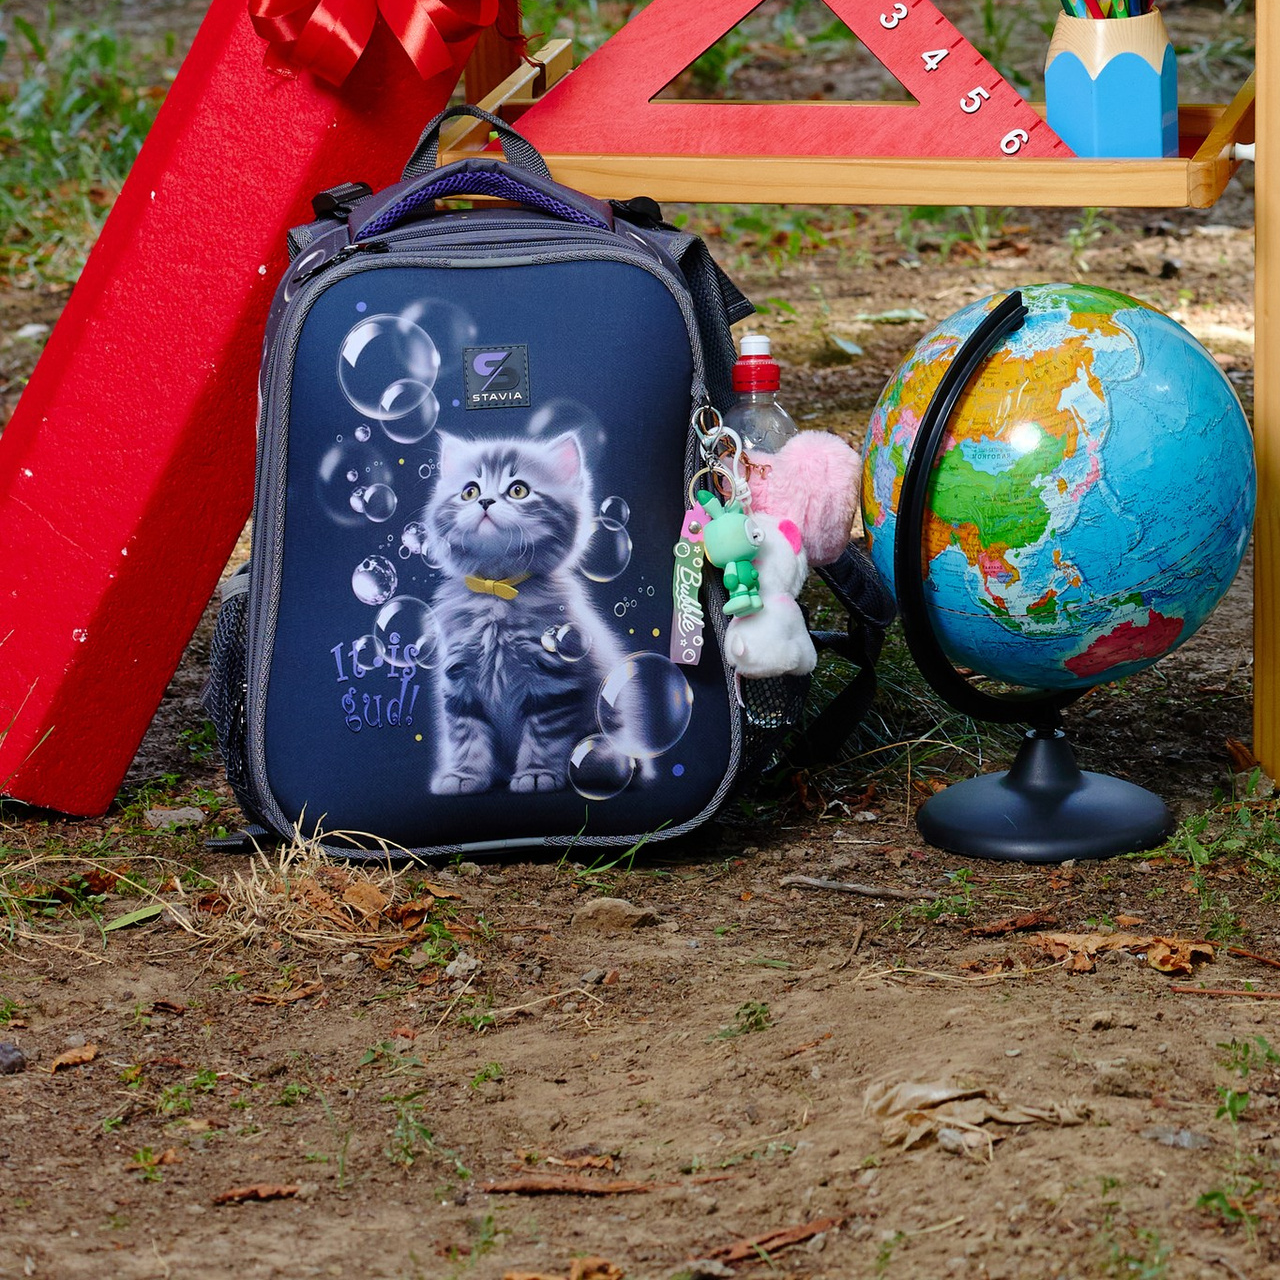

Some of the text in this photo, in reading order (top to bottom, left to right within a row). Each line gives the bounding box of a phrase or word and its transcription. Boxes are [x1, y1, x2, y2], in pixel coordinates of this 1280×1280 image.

[879, 2, 909, 29] 3
[920, 48, 949, 73] 4
[959, 86, 991, 114] 5
[1000, 128, 1029, 155] 6
[472, 391, 523, 403] STAVIA
[679, 565, 706, 633] Bubble
[387, 631, 420, 680] is
